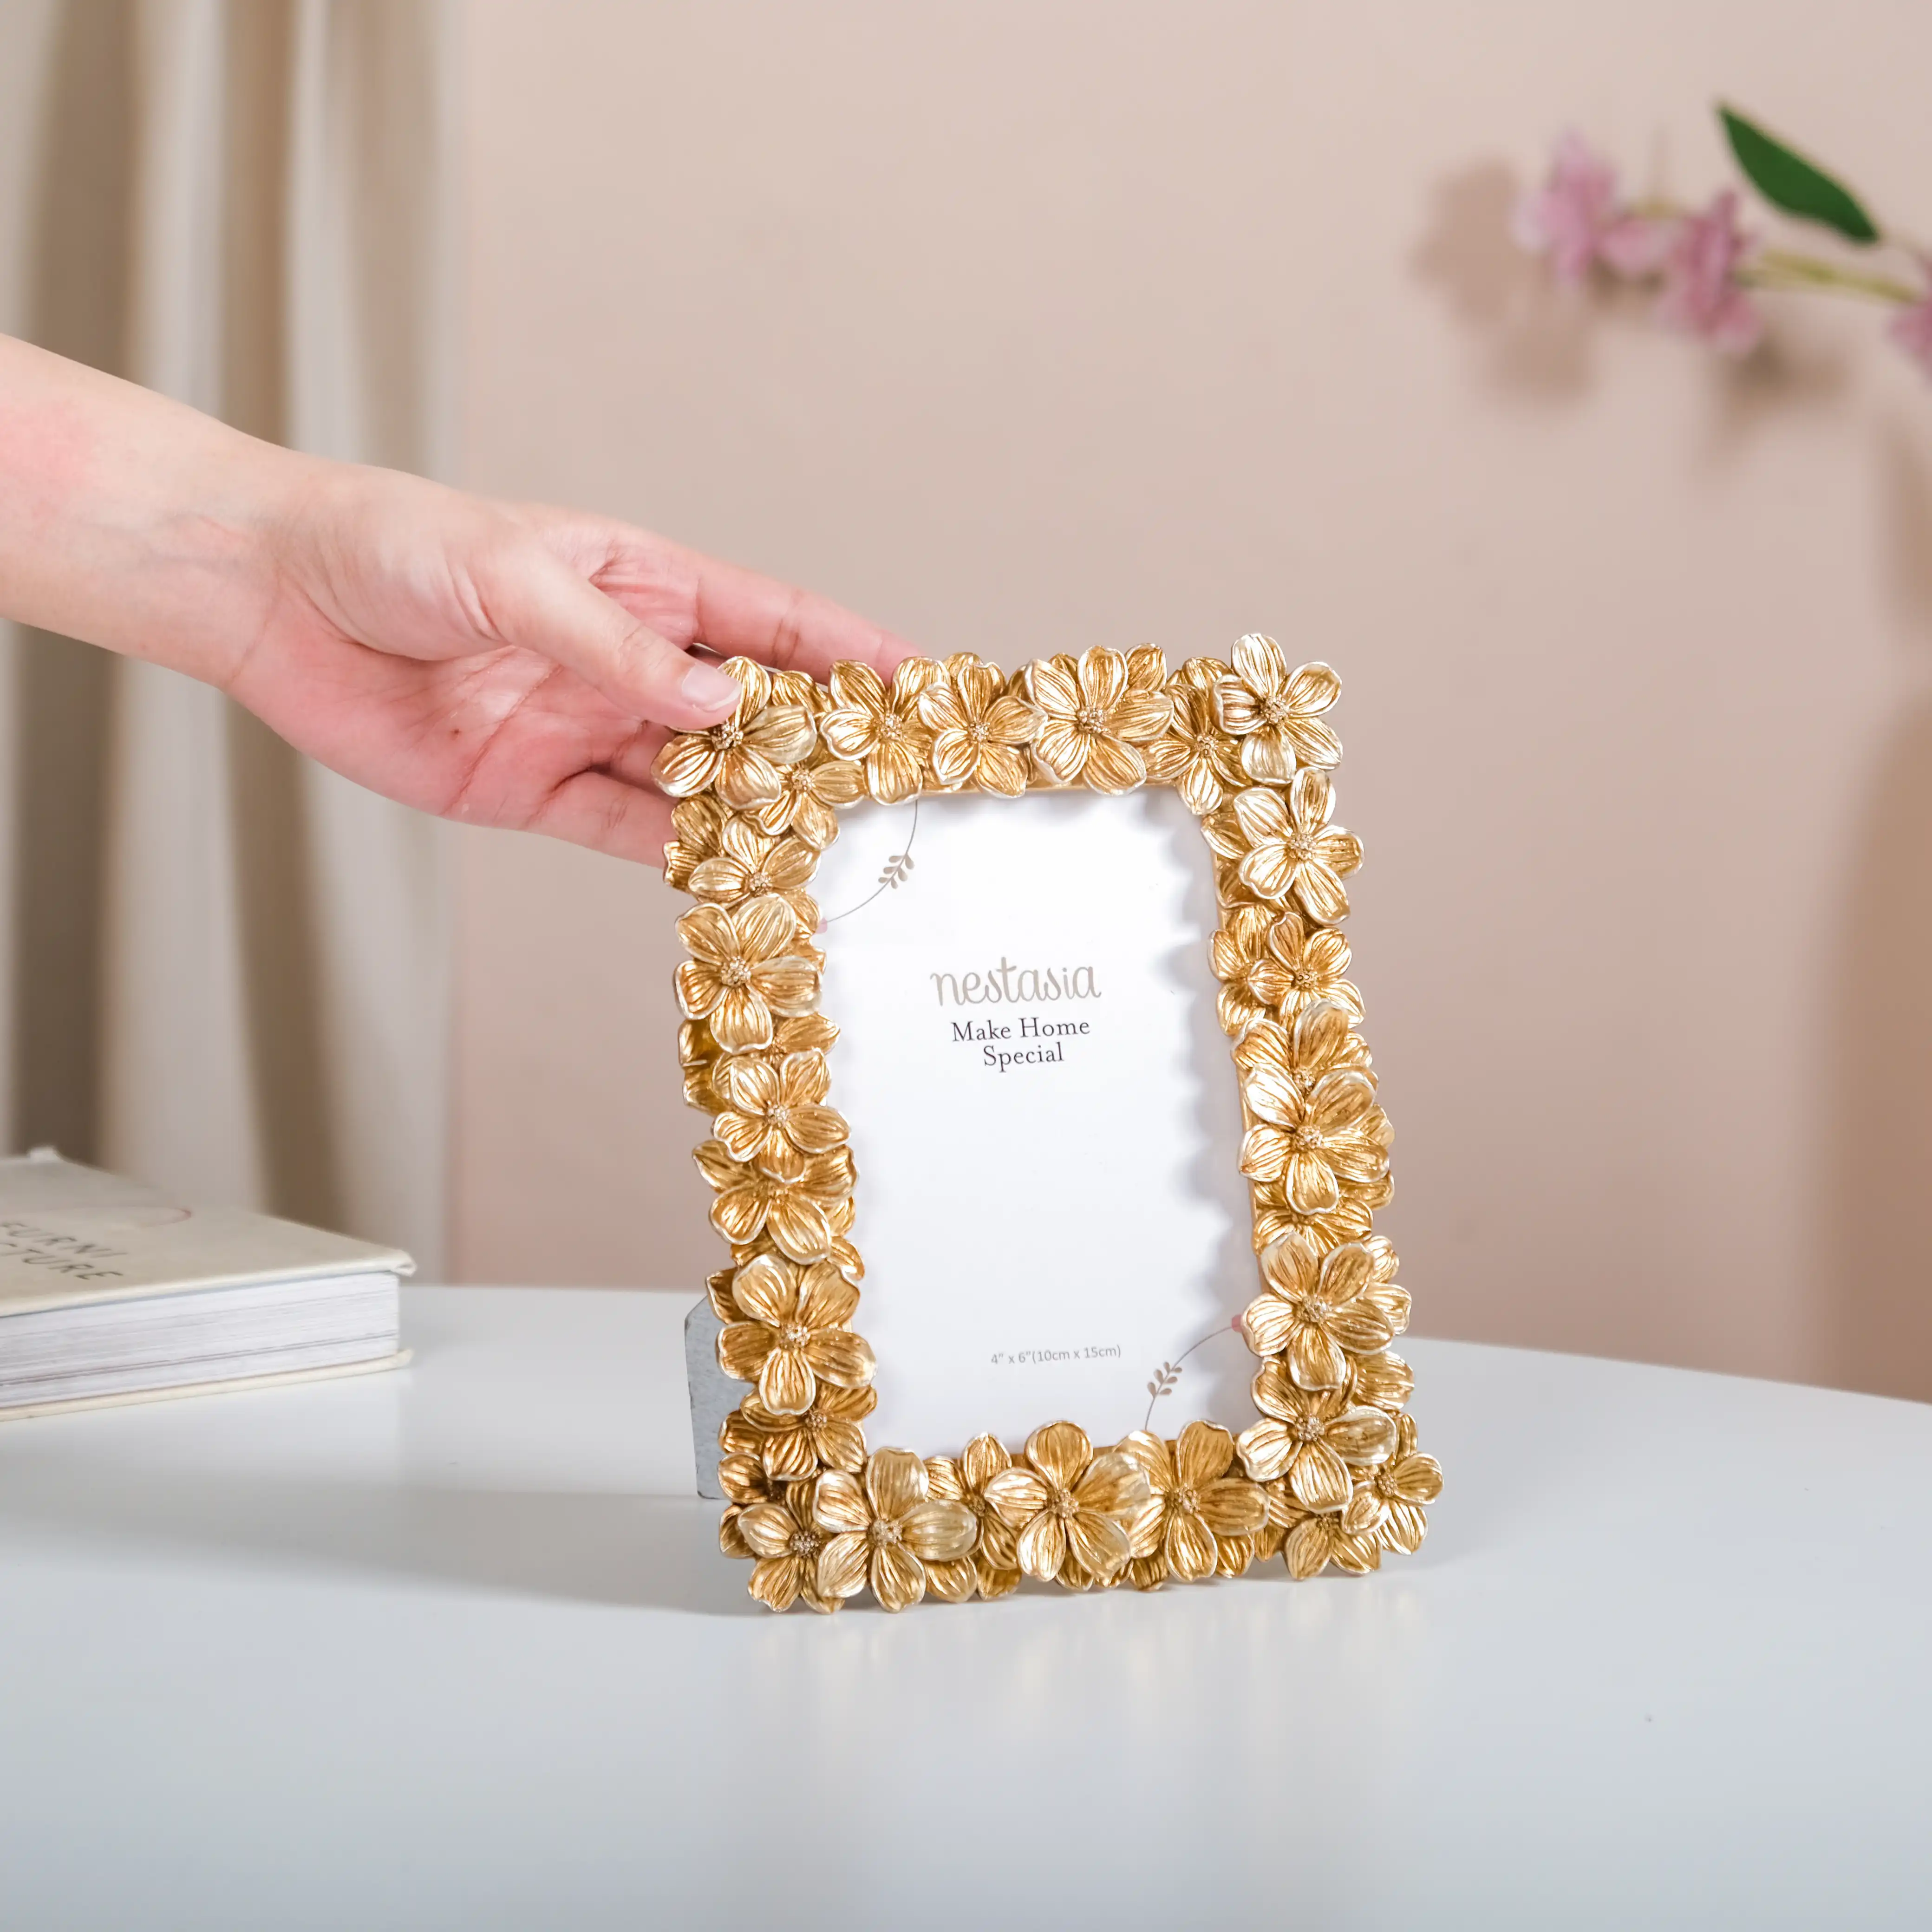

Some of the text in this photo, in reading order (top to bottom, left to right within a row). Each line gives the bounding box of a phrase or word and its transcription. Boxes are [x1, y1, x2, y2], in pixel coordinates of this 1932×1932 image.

[930, 956, 1102, 1006] nestasia
[951, 1017, 1090, 1042] Make Home
[984, 1041, 1064, 1073] Special
[1008, 1356, 1015, 1364] x
[1074, 1351, 1080, 1359] x
[1084, 1345, 1121, 1358] 15cm)
